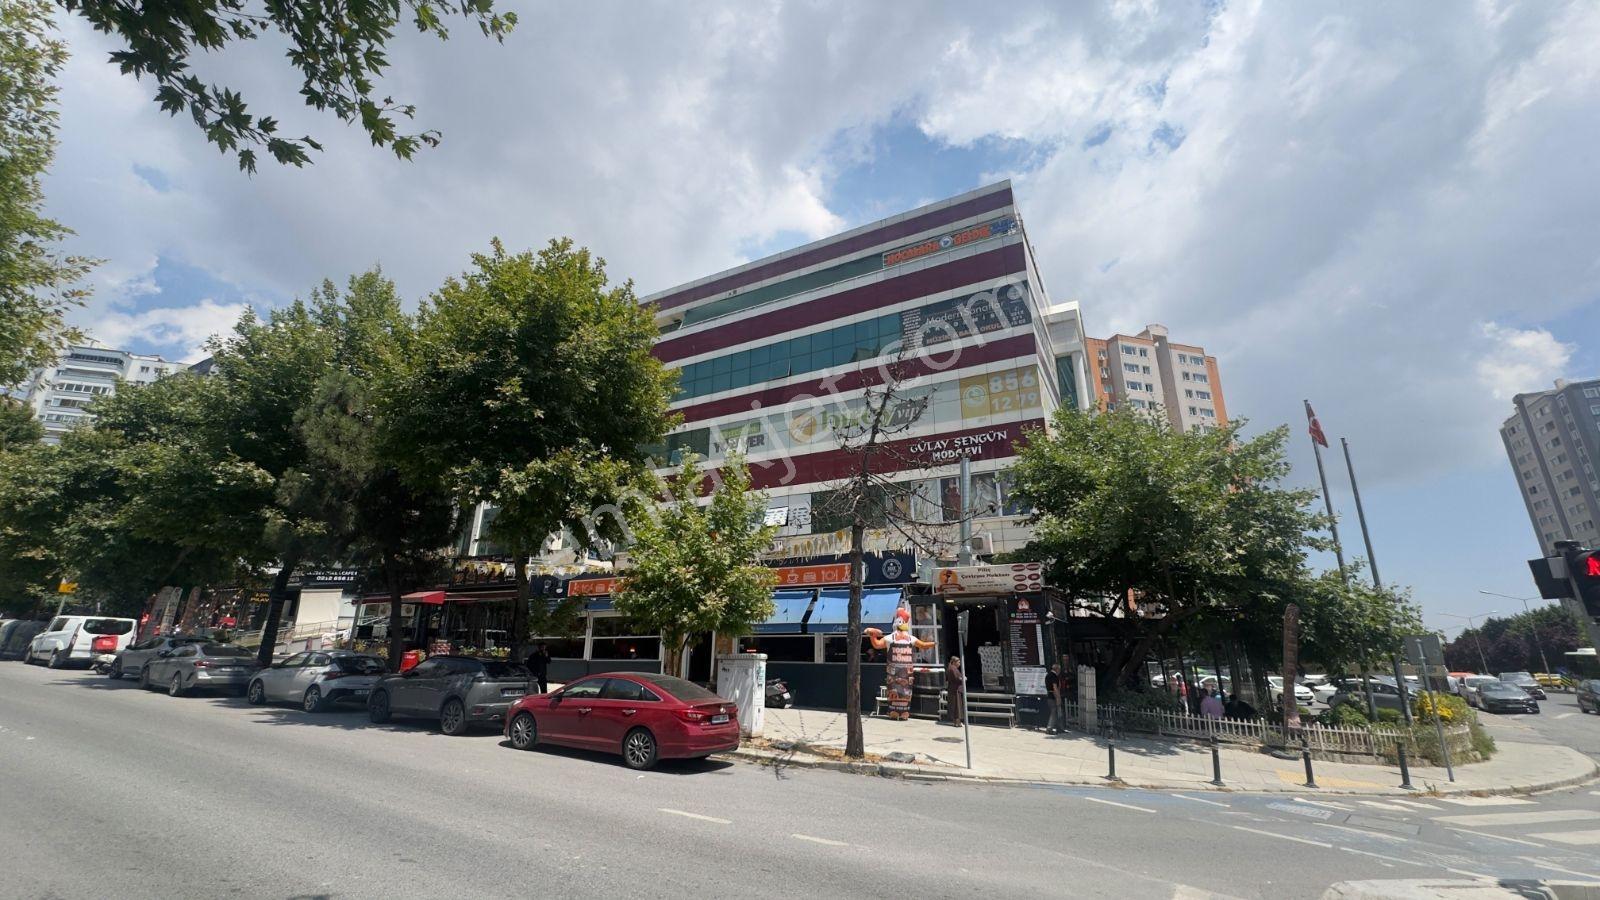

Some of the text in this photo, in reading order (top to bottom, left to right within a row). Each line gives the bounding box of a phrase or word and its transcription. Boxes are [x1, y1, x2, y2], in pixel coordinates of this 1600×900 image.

[926, 311, 961, 323] Modern
[989, 371, 1038, 394] 856
[992, 392, 1038, 411] 12 79
[910, 431, 1008, 453] GÜLAY ŞENGÜN
